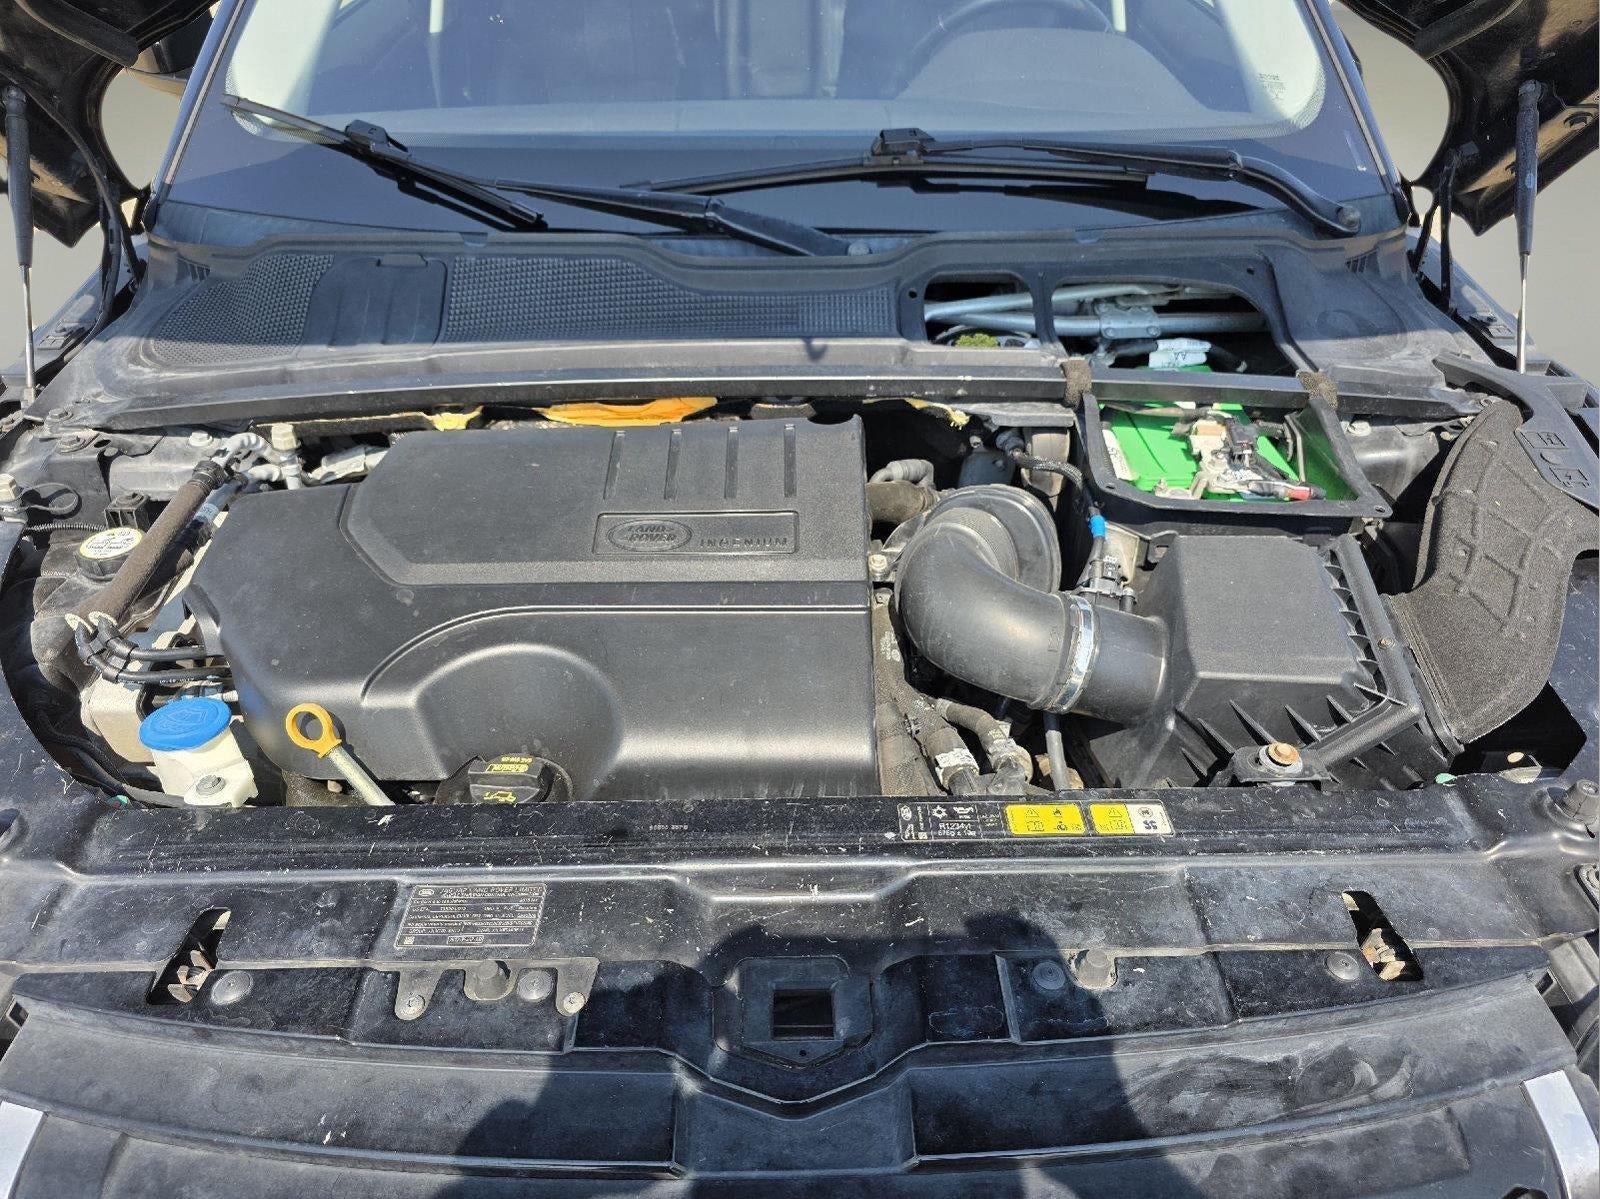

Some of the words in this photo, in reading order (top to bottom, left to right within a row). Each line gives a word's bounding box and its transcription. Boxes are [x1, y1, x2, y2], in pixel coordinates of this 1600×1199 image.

[628, 524, 670, 534] LAND
[629, 533, 677, 543] ROVER
[700, 537, 788, 548] INGENIUM
